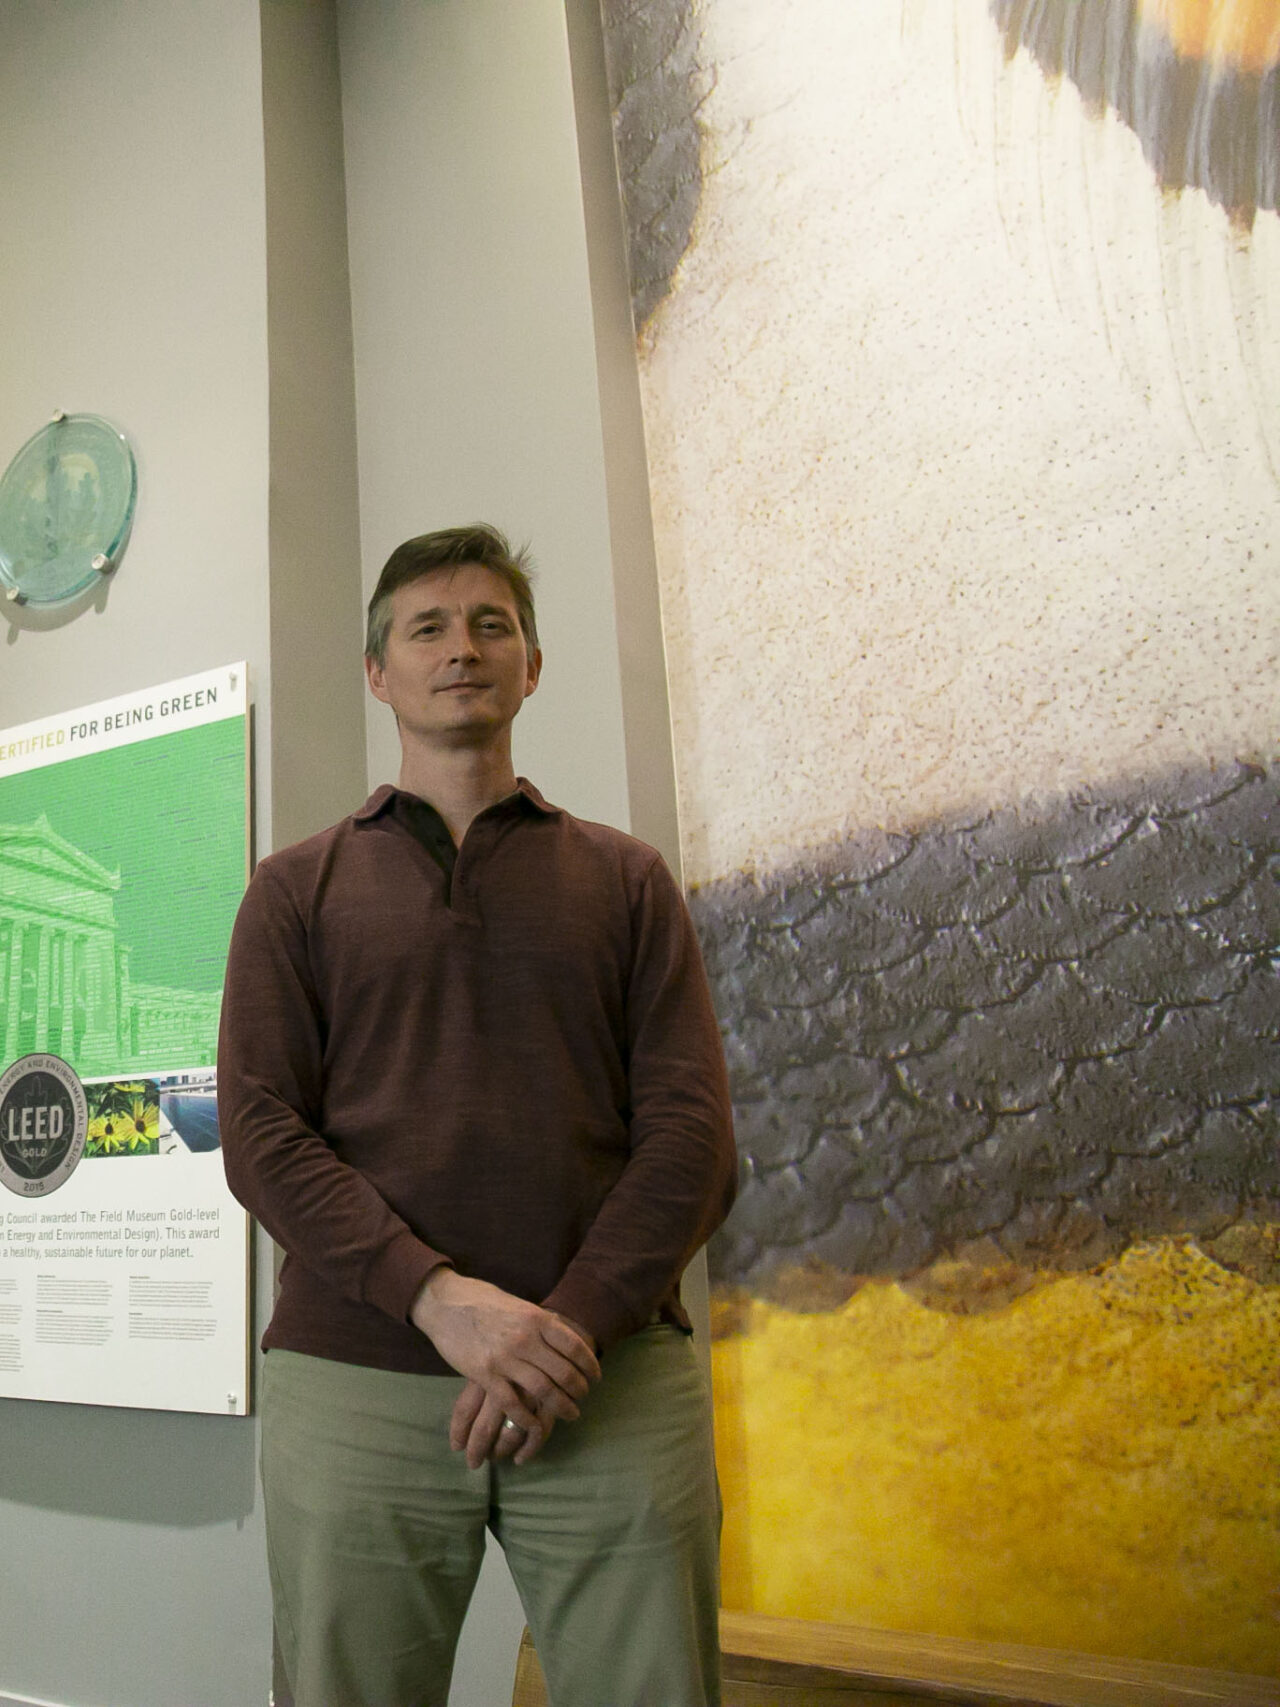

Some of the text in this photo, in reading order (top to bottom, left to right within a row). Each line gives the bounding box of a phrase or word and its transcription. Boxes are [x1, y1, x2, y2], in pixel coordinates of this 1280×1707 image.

[70, 720, 98, 742] FOR
[104, 705, 154, 733] BEING
[160, 687, 218, 717] GREEN
[28, 1059, 44, 1068] AND
[45, 1060, 85, 1126] ENVIRONMENTAL
[8, 1105, 64, 1141] LEED
[22, 1148, 47, 1158] GOLD
[64, 1132, 84, 1169] DESIGN
[23, 1181, 45, 1192] 2015
[7, 1212, 38, 1224] Council
[41, 1211, 77, 1223] awarded
[80, 1210, 96, 1222] The
[100, 1210, 122, 1222] Field
[126, 1209, 166, 1221] Museum
[170, 1208, 219, 1221] Gold-level
[7, 1229, 36, 1243] Energy
[38, 1228, 53, 1240] and
[56, 1228, 121, 1240] Environmental
[124, 1227, 162, 1242] Design).
[166, 1227, 186, 1239] This
[189, 1226, 219, 1239] award
[3, 1249, 8, 1257] a
[10, 1247, 42, 1260] healthy,
[44, 1246, 93, 1258] sustainable
[95, 1246, 122, 1258] future
[126, 1246, 138, 1258] for
[141, 1248, 156, 1258] our
[160, 1247, 194, 1260] planet.
